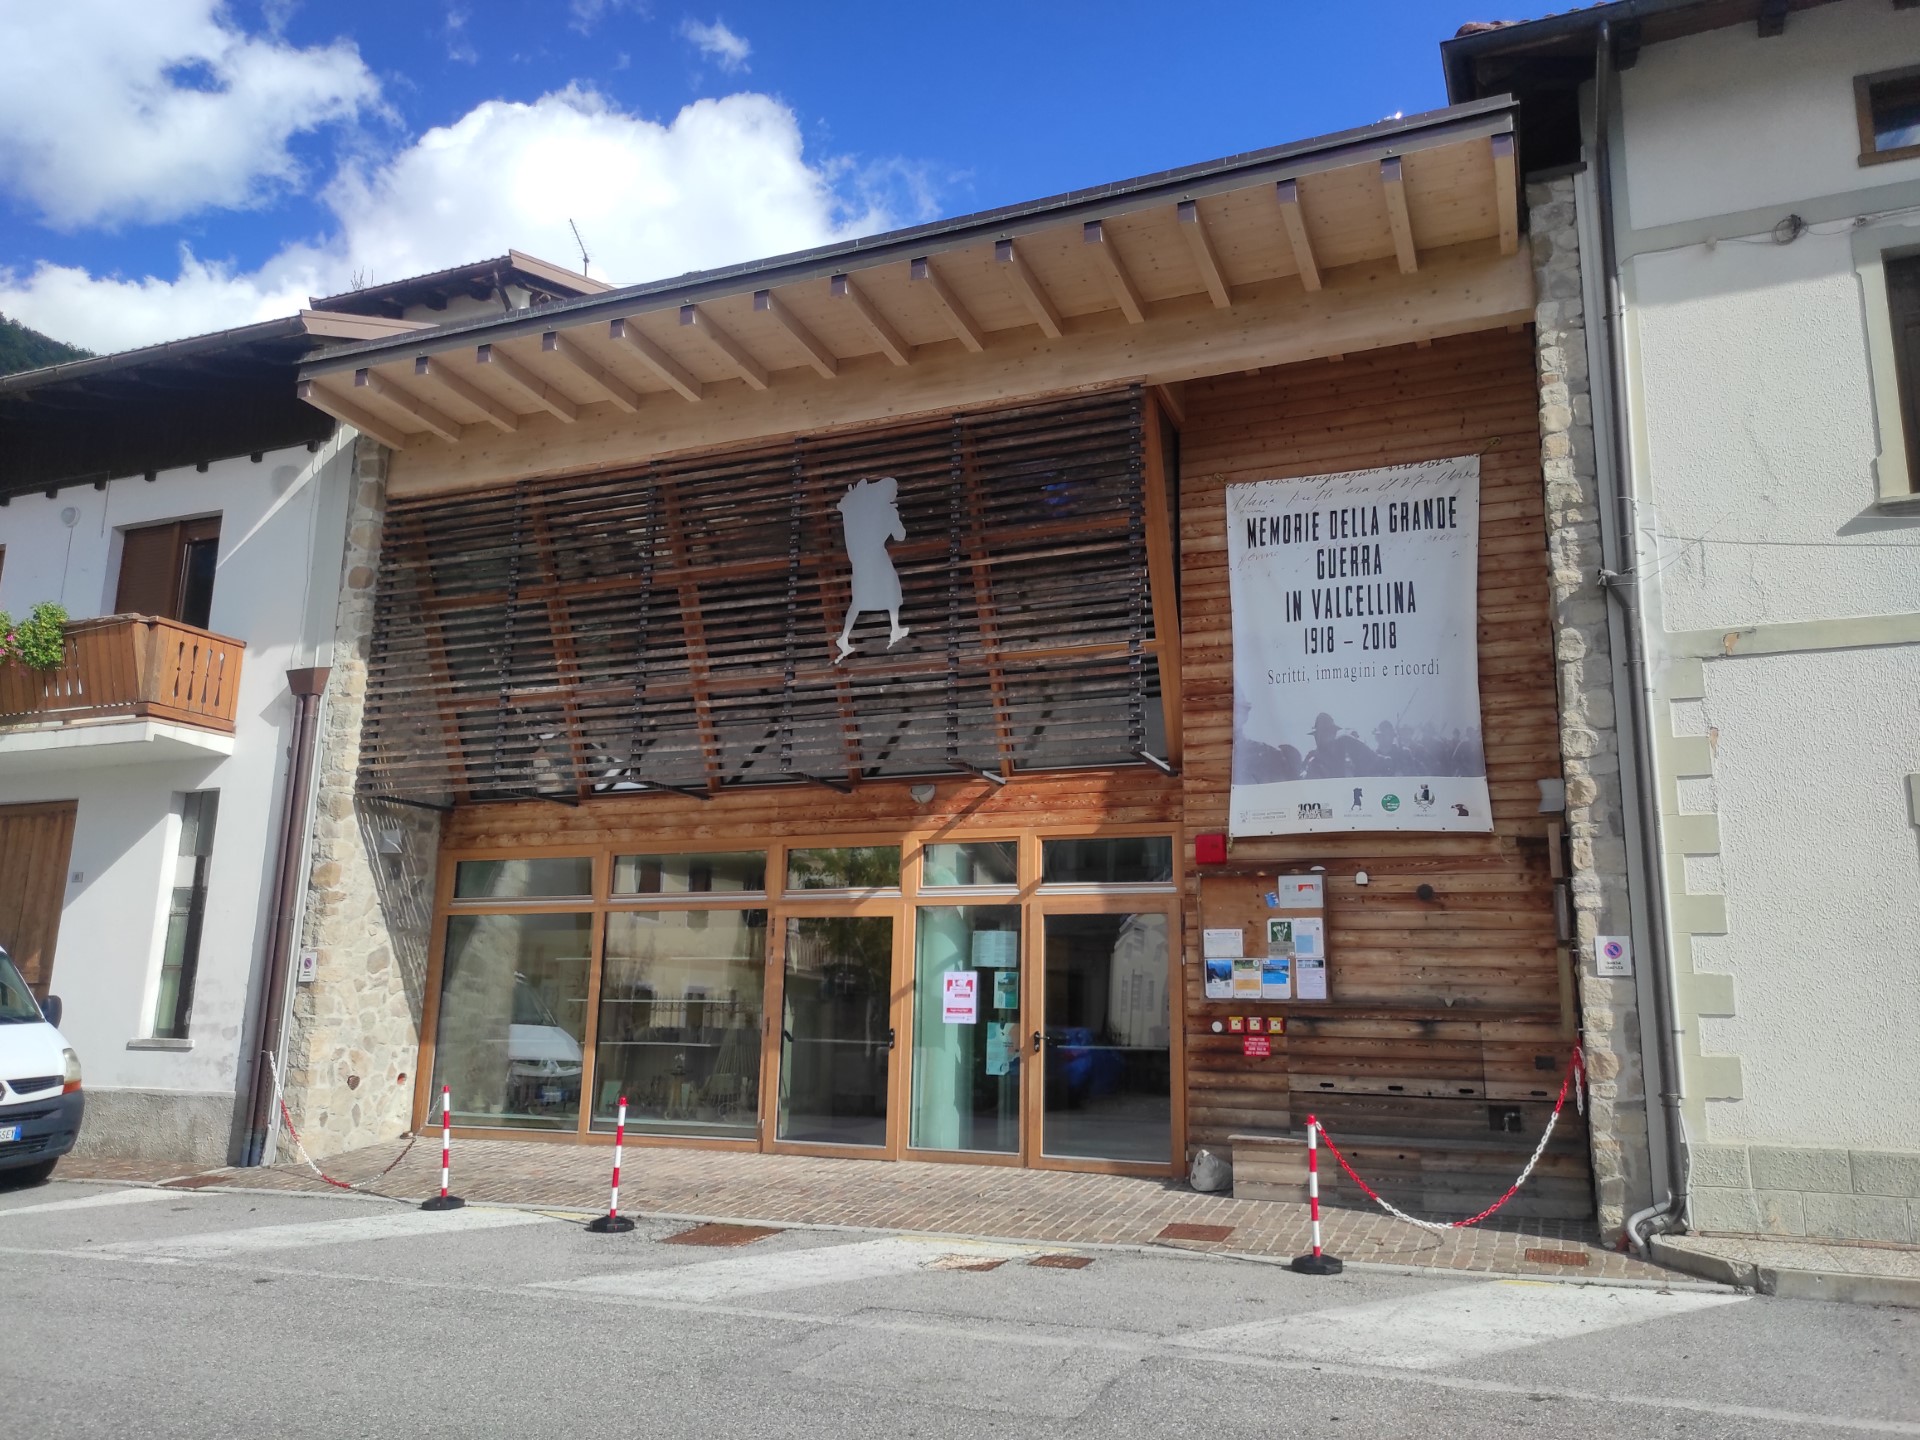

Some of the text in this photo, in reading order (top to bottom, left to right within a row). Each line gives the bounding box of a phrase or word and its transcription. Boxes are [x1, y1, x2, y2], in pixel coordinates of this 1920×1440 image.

[1246, 496, 1457, 549] MEMORIE DELLA GRANDE
[1316, 543, 1382, 580] GUERRA
[1285, 580, 1417, 623] IN VALCELLINA
[1304, 625, 1335, 655] 1918
[1362, 621, 1397, 651] 2018
[1267, 658, 1440, 685] Scritti, immagini e ricordi
